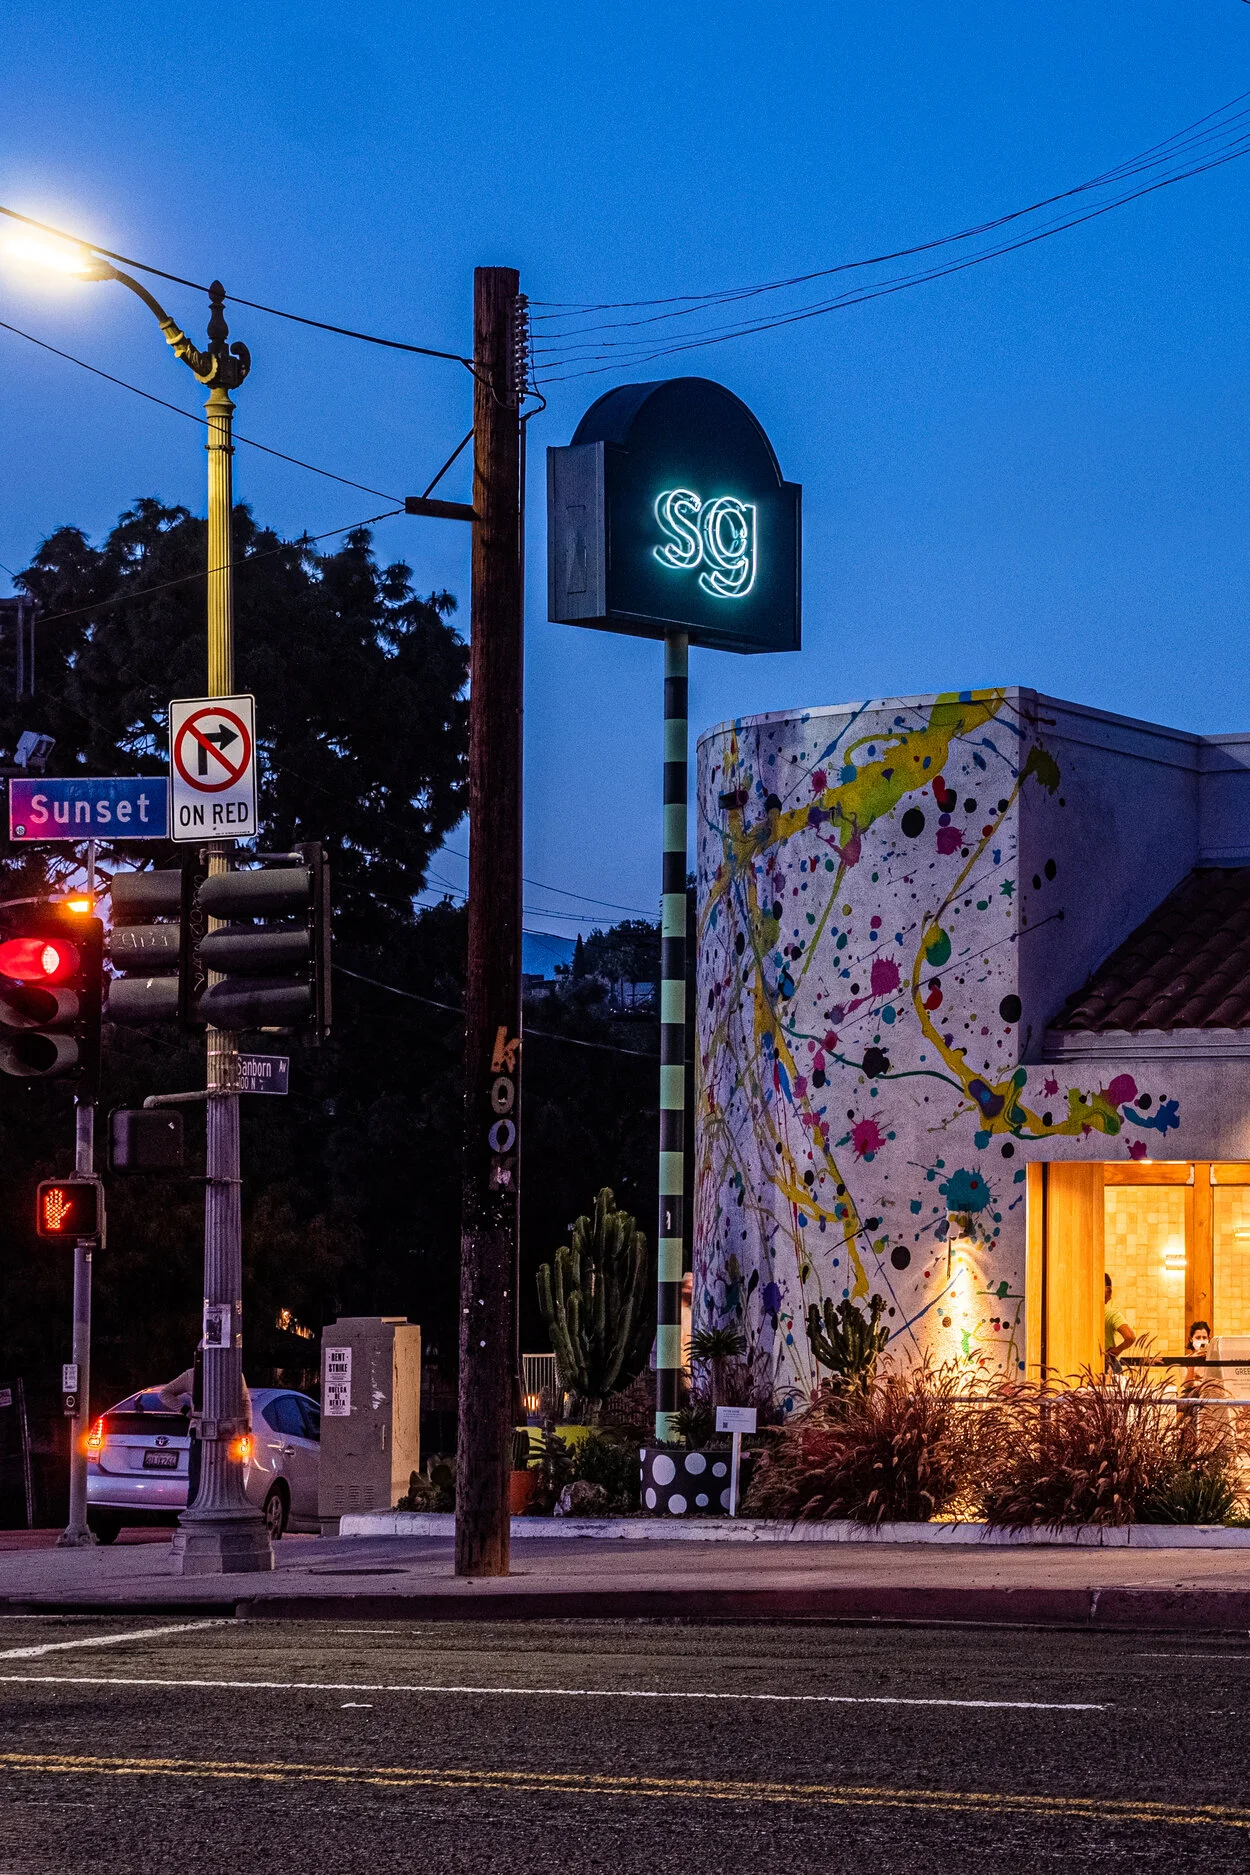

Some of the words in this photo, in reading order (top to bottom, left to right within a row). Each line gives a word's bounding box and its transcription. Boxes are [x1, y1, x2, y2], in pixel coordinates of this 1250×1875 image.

[653, 488, 757, 598] sg
[29, 792, 150, 824] Sunset
[180, 805, 204, 826] ON
[213, 802, 249, 824] RED
[238, 1057, 272, 1078] Sanborn
